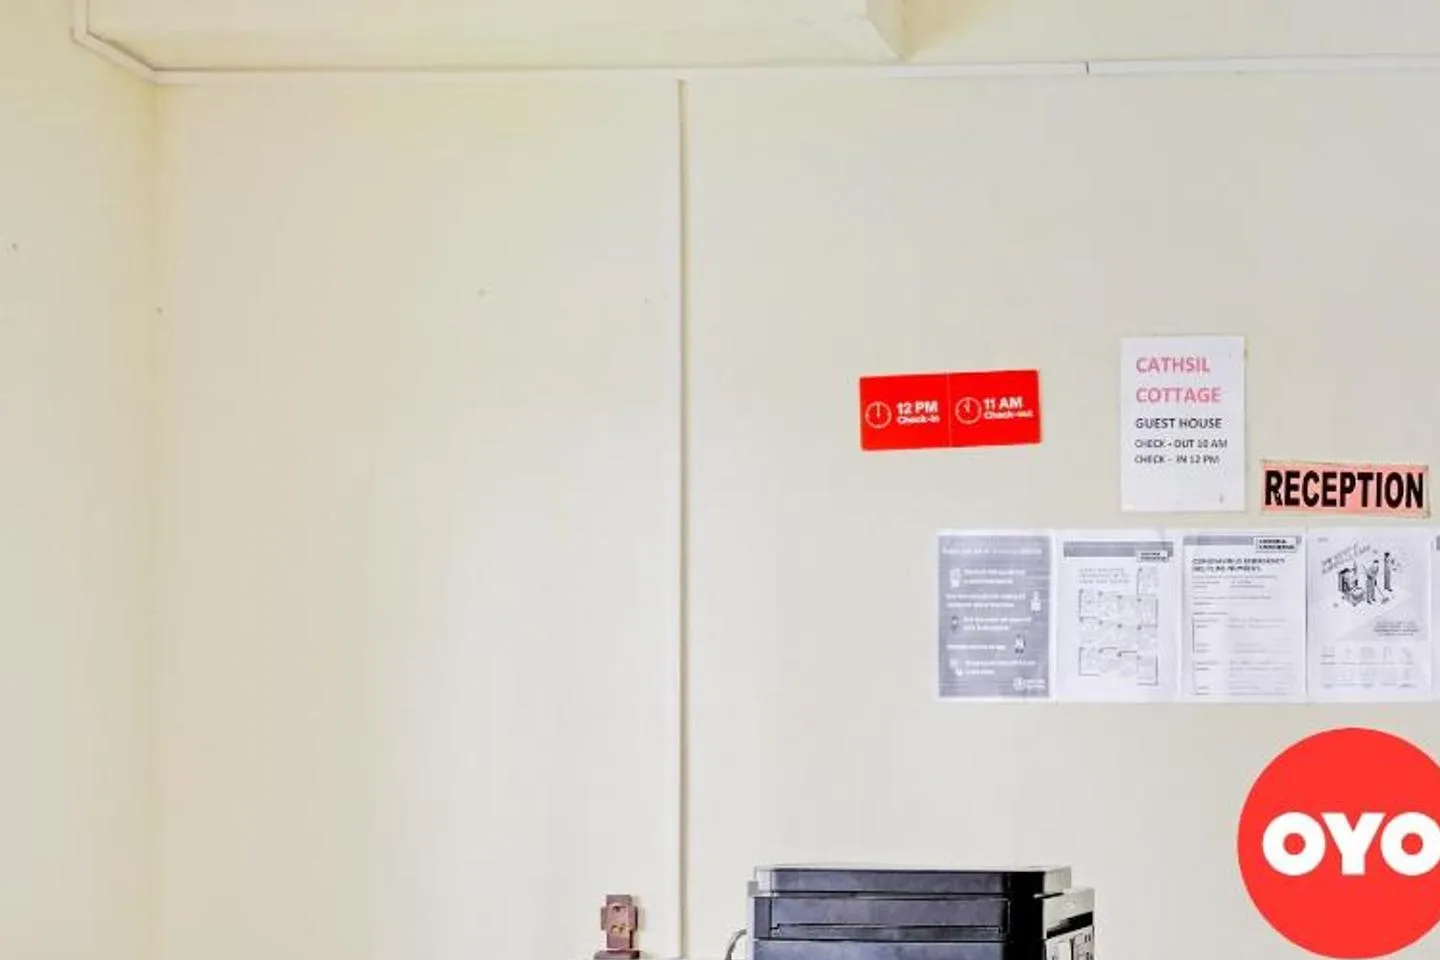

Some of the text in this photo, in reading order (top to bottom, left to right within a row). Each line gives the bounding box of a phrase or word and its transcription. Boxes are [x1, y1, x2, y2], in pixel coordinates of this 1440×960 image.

[1135, 356, 1211, 373] CATHSIL
[1135, 387, 1223, 403] COTTAGE
[896, 400, 938, 415] 12 PM
[983, 396, 1023, 410] 11 AM
[1135, 418, 1223, 429] GUEST HOUSE
[1264, 470, 1424, 509] RECEPTION
